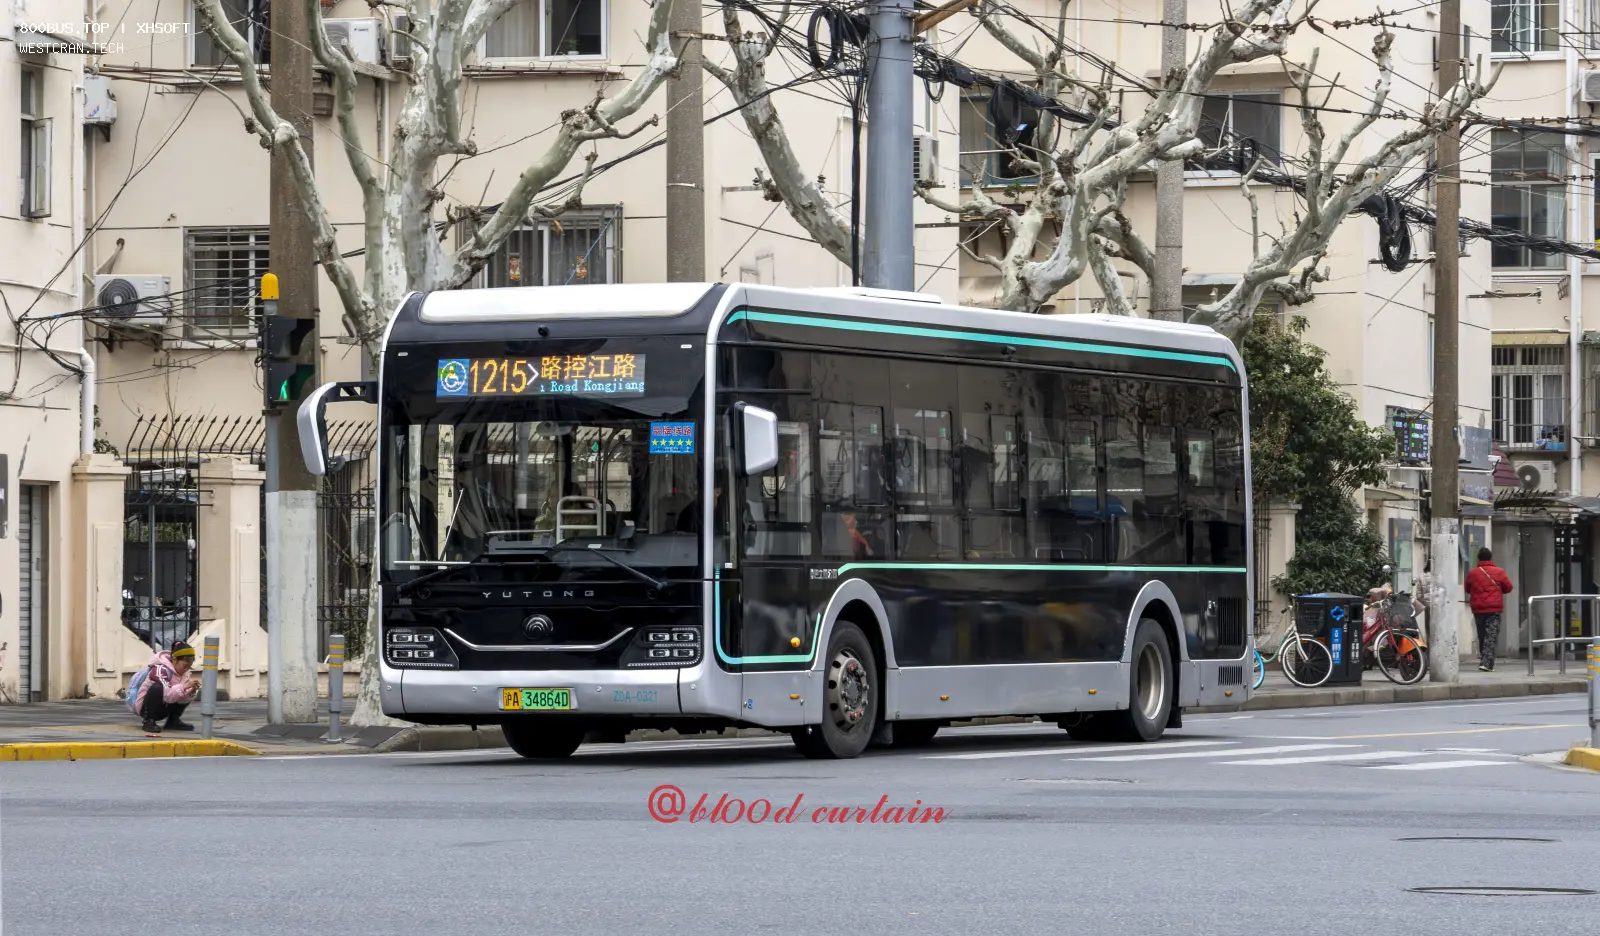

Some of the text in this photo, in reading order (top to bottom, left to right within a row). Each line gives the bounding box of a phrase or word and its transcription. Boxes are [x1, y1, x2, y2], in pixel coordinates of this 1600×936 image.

[541, 354, 636, 380] 路控江路
[470, 359, 527, 393] 1215
[550, 379, 578, 392] Road
[584, 378, 645, 393] Kongjiang
[482, 590, 595, 599] YUTONG
[525, 691, 569, 707] 34864D
